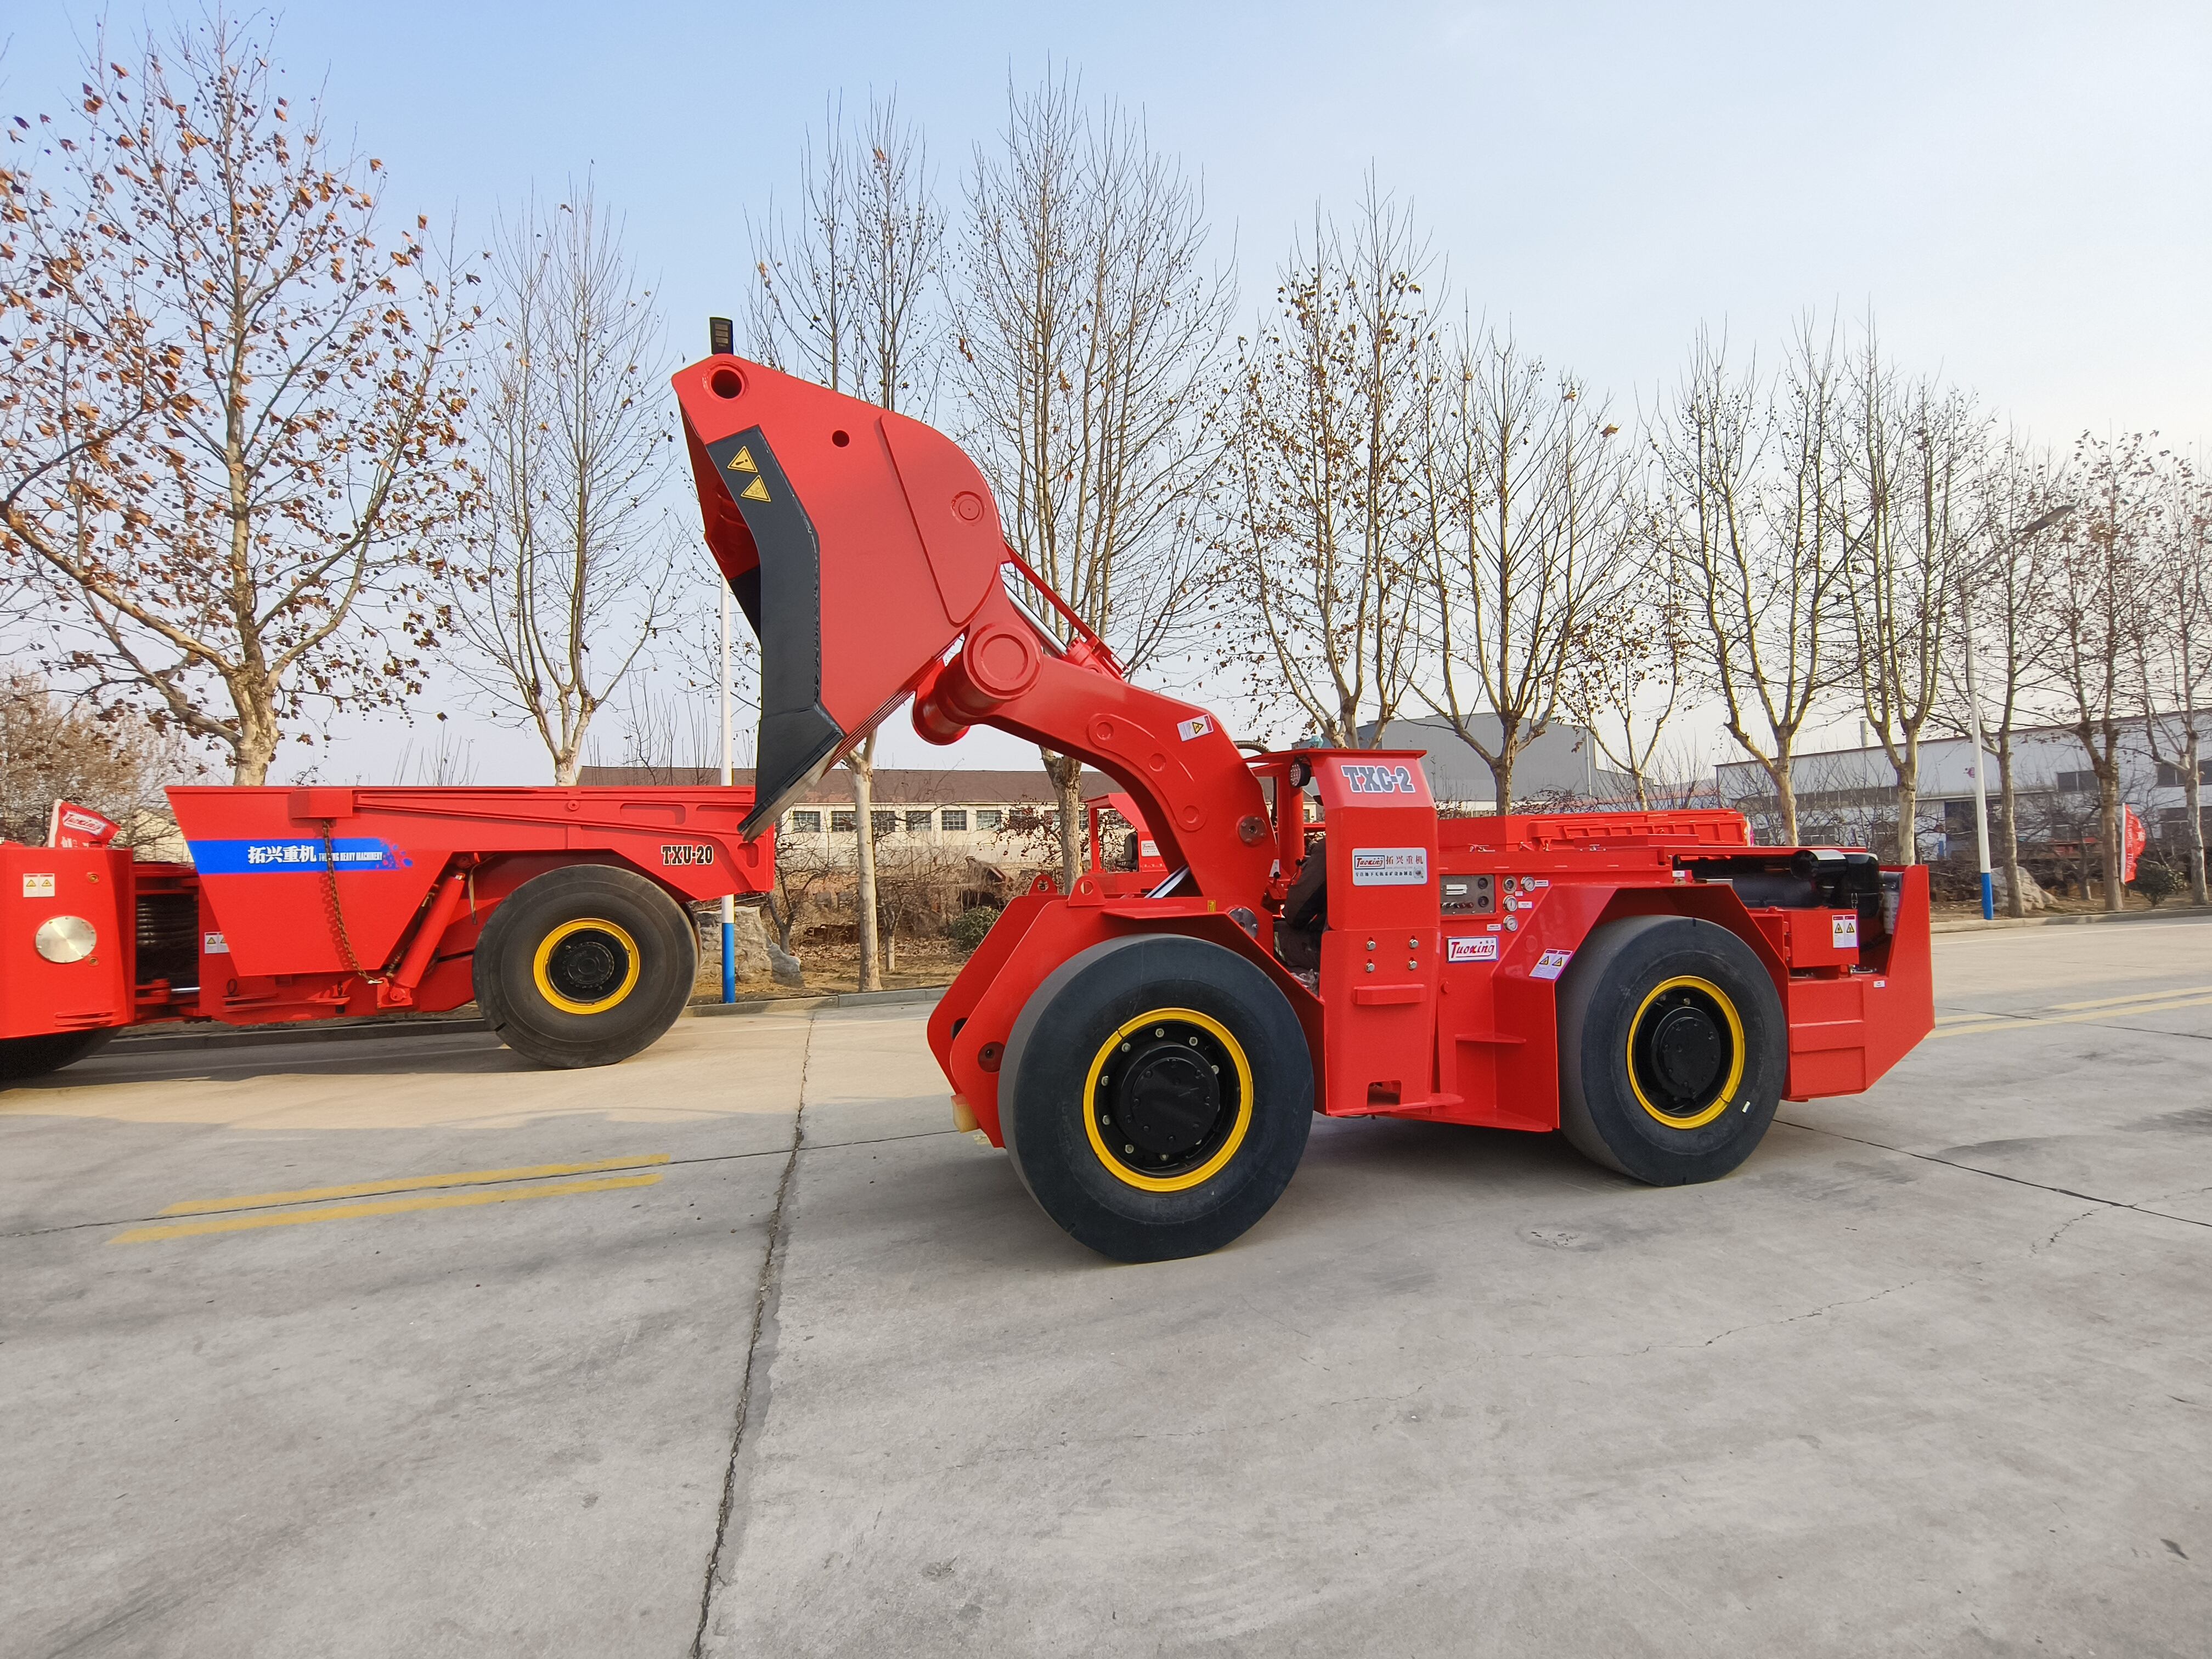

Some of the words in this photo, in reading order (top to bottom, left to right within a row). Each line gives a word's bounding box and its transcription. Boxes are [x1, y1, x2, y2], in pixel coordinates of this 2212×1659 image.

[1341, 765, 1415, 793] TXC-2
[247, 845, 317, 864] 拓兴重机
[340, 852, 356, 861] HEAVY
[661, 845, 713, 865] TXU-20
[1386, 855, 1424, 865] 拓兴重机
[1451, 941, 1495, 958] Tuoxing
